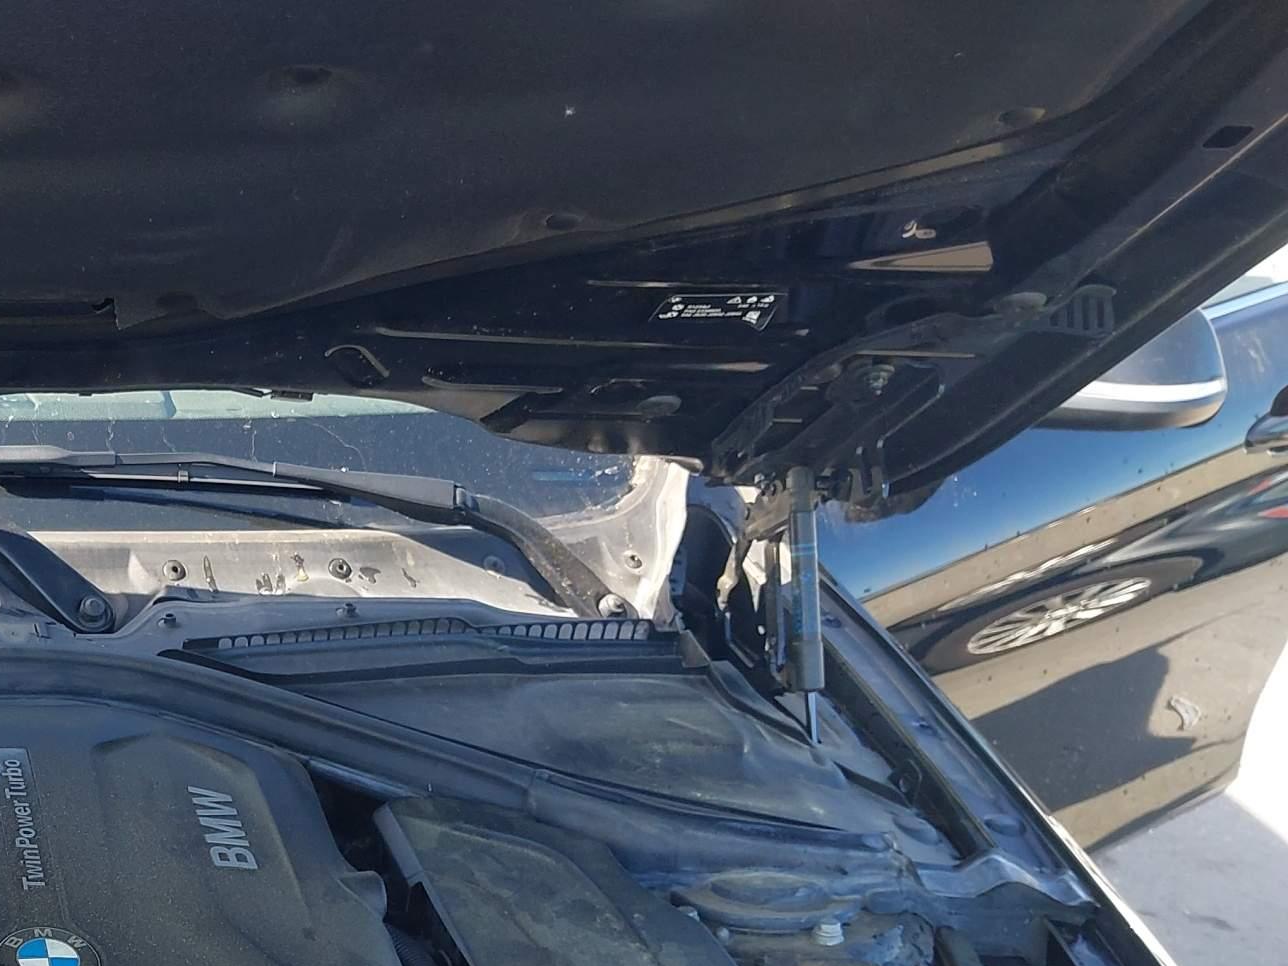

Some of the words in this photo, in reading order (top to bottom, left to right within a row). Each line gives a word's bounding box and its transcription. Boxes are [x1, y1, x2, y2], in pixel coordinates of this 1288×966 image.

[0, 758, 28, 800] Turbo
[12, 799, 46, 891] TwinPower
[187, 785, 259, 870] BMW
[4, 927, 88, 949] BMW
